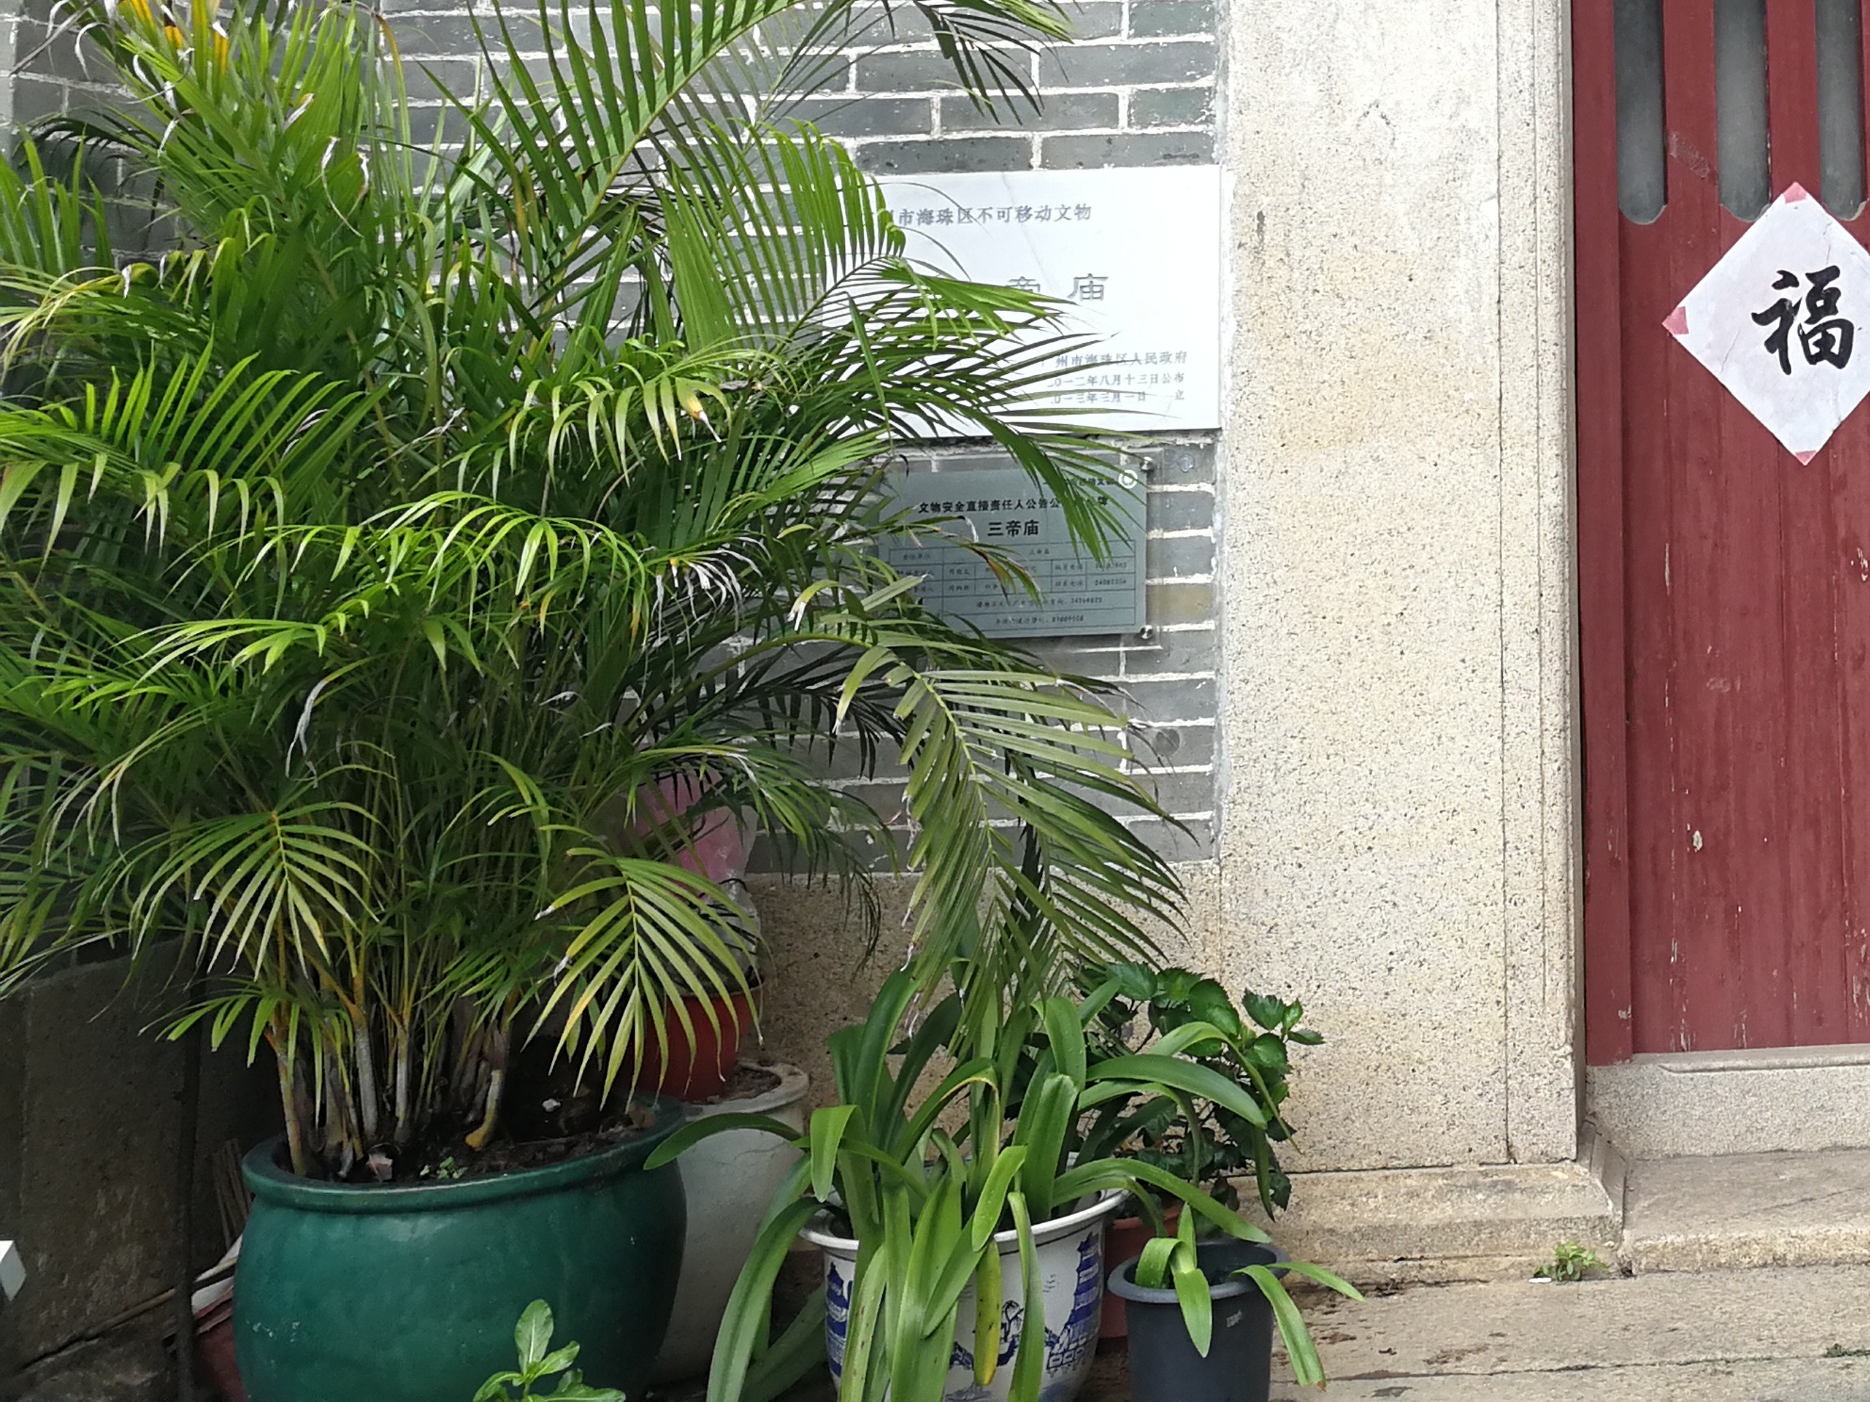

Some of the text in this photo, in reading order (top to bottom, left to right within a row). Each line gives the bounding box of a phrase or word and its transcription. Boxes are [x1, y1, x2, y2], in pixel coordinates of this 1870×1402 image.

[884, 202, 1092, 227] 市海珠区不可移动文物
[1006, 273, 1109, 302] 帝庙
[1751, 264, 1856, 376] 福
[1044, 351, 1188, 369] 州市海珠区人民政府
[987, 519, 1040, 538] 三帝庙
